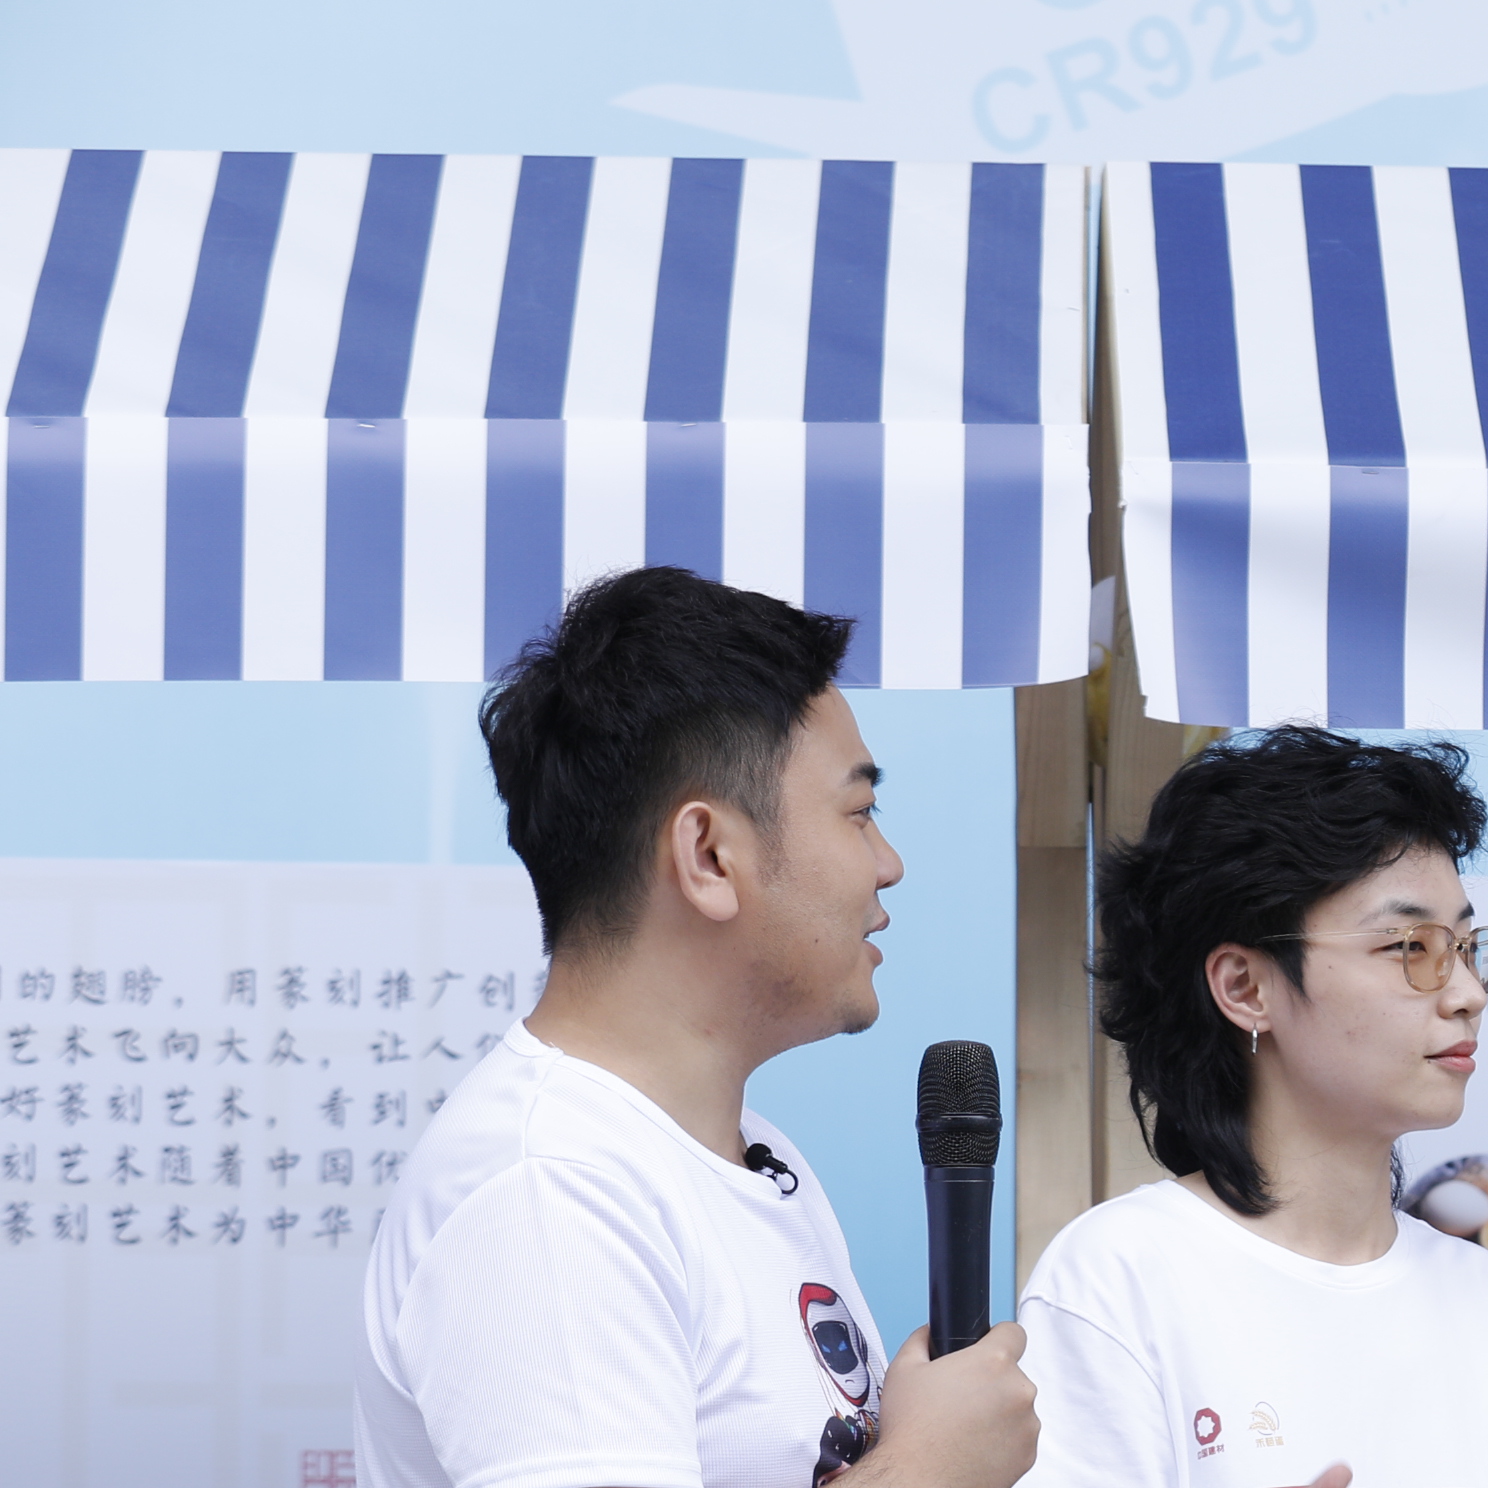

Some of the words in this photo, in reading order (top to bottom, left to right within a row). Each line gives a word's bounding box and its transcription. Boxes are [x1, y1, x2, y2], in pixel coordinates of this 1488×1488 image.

[970, 0, 1319, 153] CR929
[0, 1200, 387, 1247] 篆刻艺术为中华
